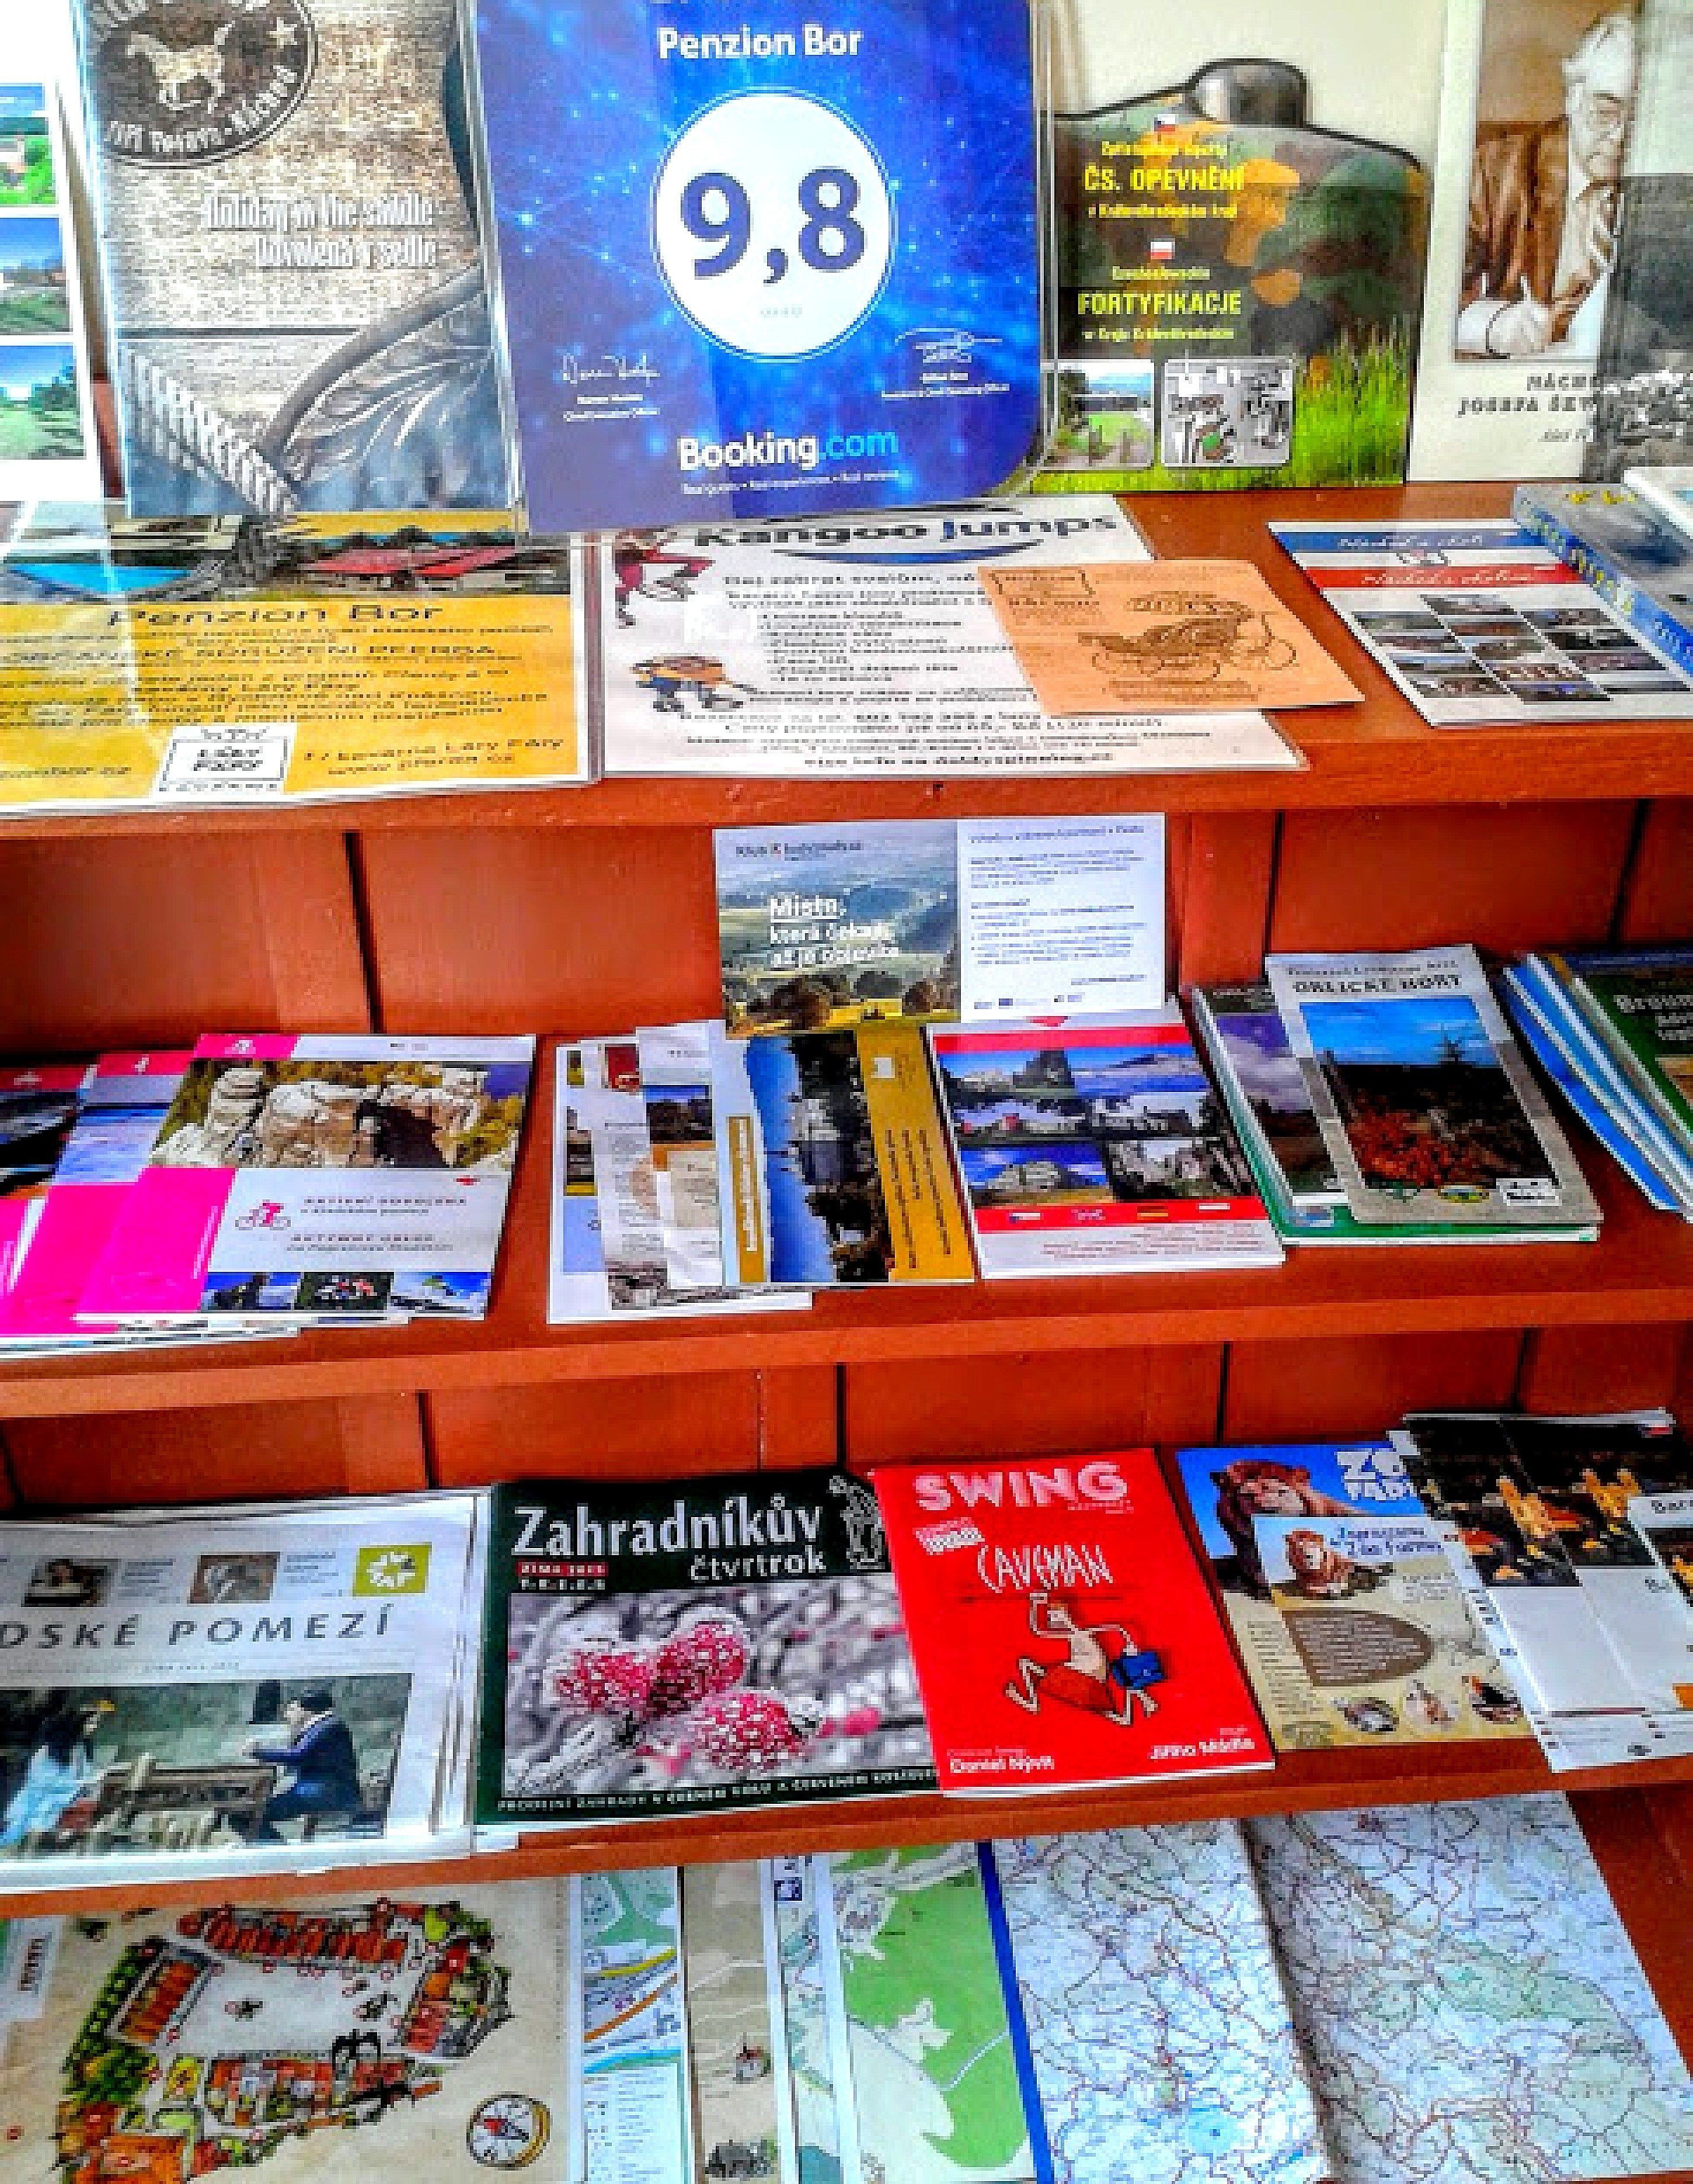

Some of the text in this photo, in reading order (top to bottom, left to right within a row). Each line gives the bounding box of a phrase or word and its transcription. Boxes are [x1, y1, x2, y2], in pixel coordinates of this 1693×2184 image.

[659, 23, 863, 59] Penzion Bor
[680, 167, 866, 284] 9,8
[1078, 290, 1242, 315] FORTYFIKACJE
[677, 430, 899, 471] Booking.com
[694, 524, 927, 547] Kangoo
[107, 604, 444, 626] Penzion Bor
[913, 1462, 1128, 1512] SWING
[510, 1492, 824, 1557] Zahradníkův
[689, 1545, 827, 1581] čtvrtrok
[977, 1543, 1114, 1594] CAVEMAN
[168, 1604, 395, 1646] POMEZÍ
